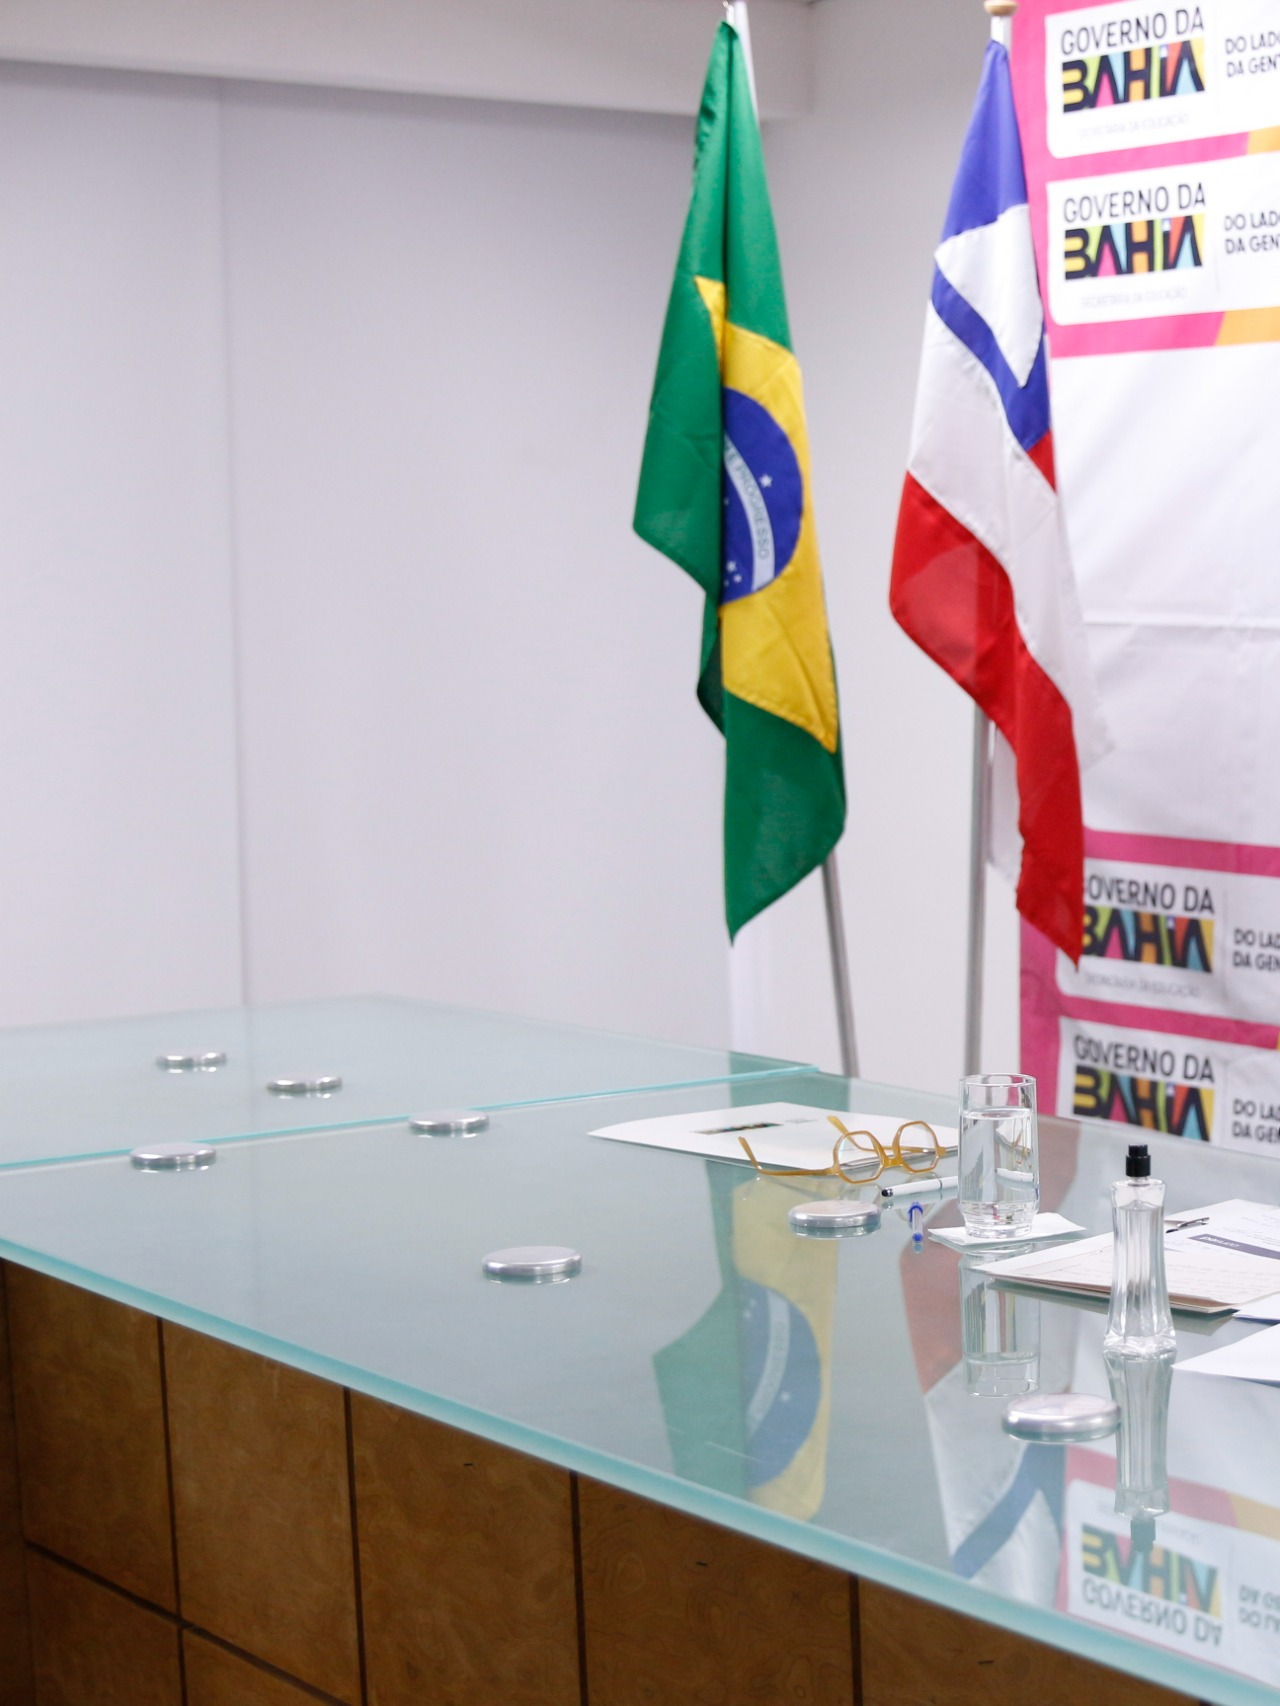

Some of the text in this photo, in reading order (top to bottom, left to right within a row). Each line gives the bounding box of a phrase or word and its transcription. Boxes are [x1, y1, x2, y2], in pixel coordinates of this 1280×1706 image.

[1061, 6, 1204, 55] GOVERNO DA
[1225, 36, 1247, 55] DO
[1062, 38, 1205, 113] BAHIA
[1226, 61, 1245, 77] DA
[1063, 182, 1206, 223] GOVERNO DA
[1225, 214, 1246, 231] DO
[1064, 212, 1204, 280] BAHIA
[1225, 238, 1245, 254] DA
[1084, 874, 1215, 914] OVERNO DA
[1083, 904, 1215, 974] BAHIA
[1234, 928, 1256, 946] DO
[1233, 952, 1251, 969] DA
[1073, 1034, 1215, 1084] GOVERNO DA
[1073, 1064, 1215, 1142] BAHIA
[1233, 1099, 1256, 1117] DO
[1232, 1121, 1251, 1138] DA
